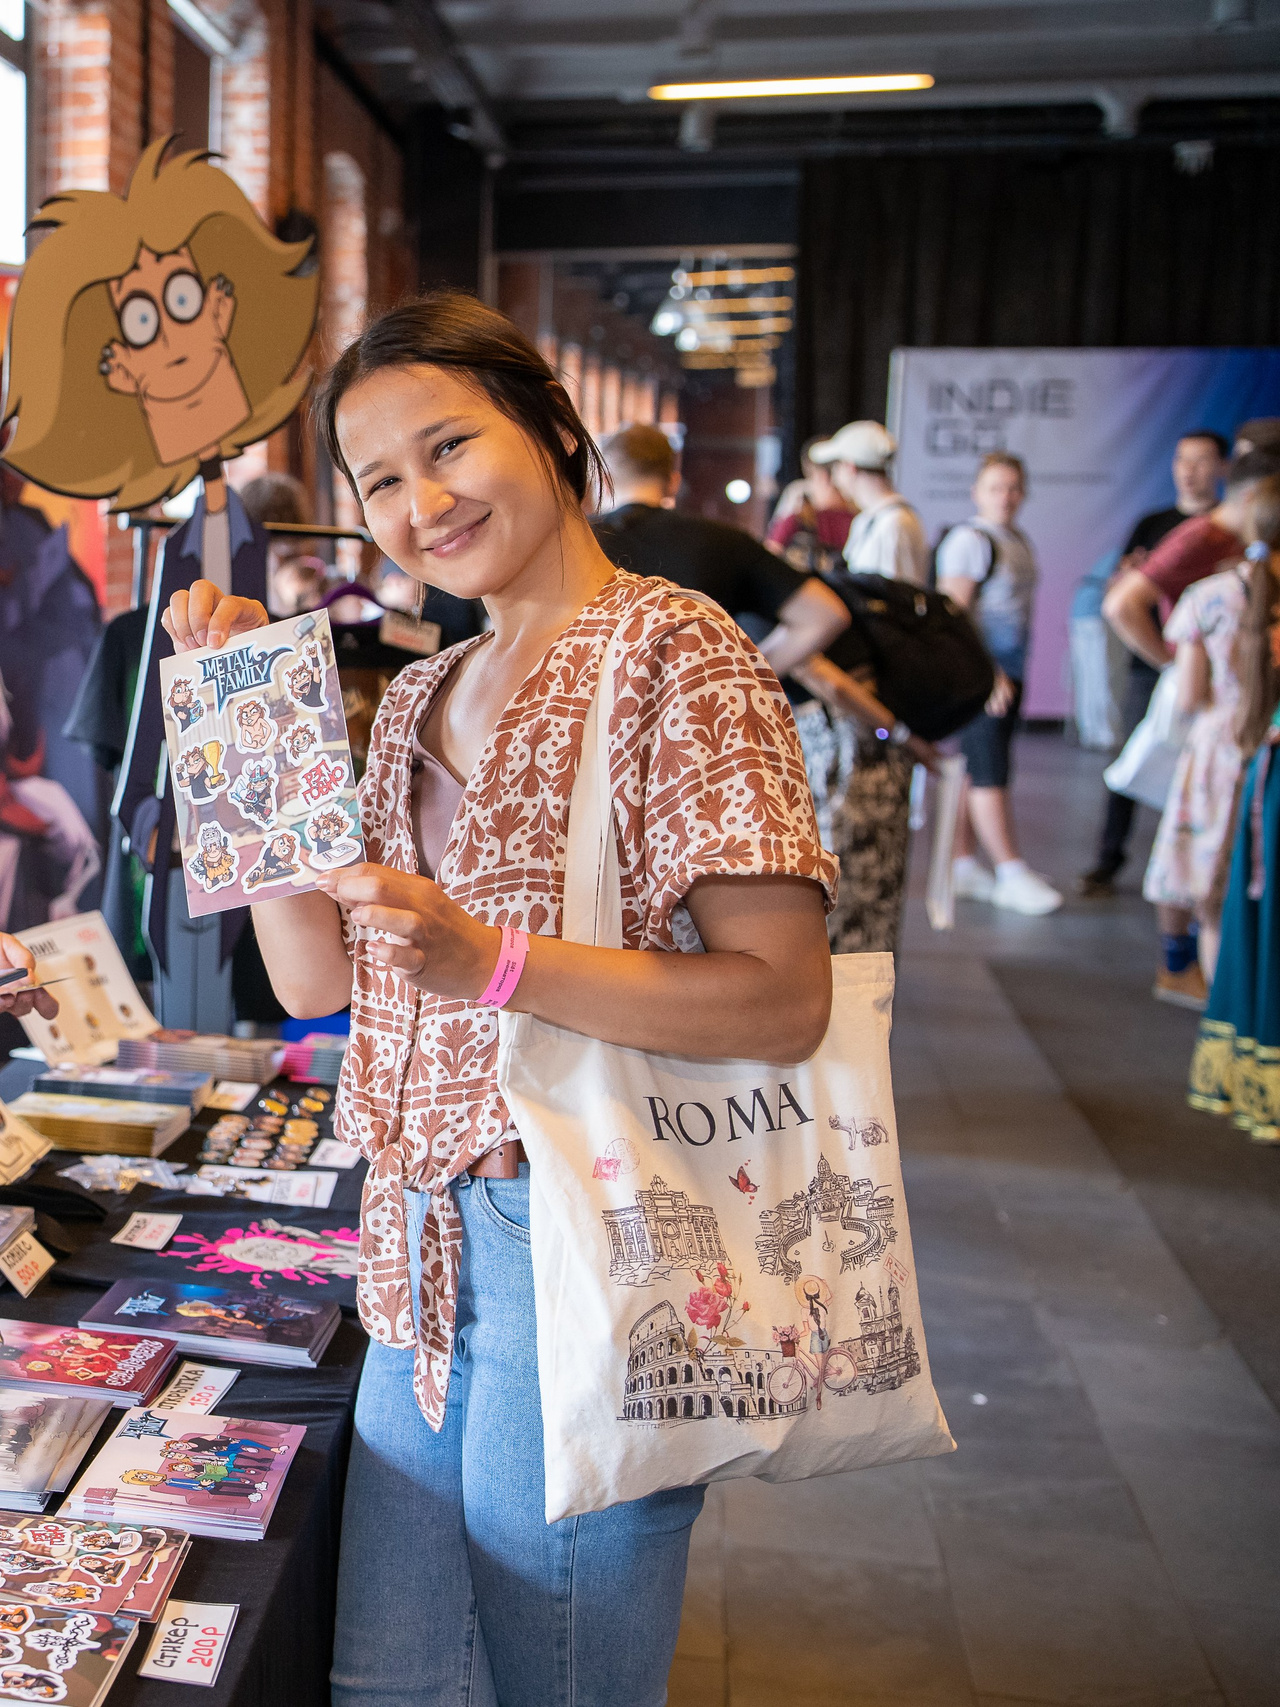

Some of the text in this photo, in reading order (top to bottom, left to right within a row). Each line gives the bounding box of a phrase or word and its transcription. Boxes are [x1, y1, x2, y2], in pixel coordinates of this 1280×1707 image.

[926, 377, 1076, 421] INDIE
[203, 649, 255, 680] METAL
[218, 663, 270, 696] FAMILY
[643, 1082, 814, 1147] ROMA
[1, 1240, 33, 1271] КОМИКС
[188, 1392, 213, 1407] 150
[186, 1638, 218, 1667] 200
